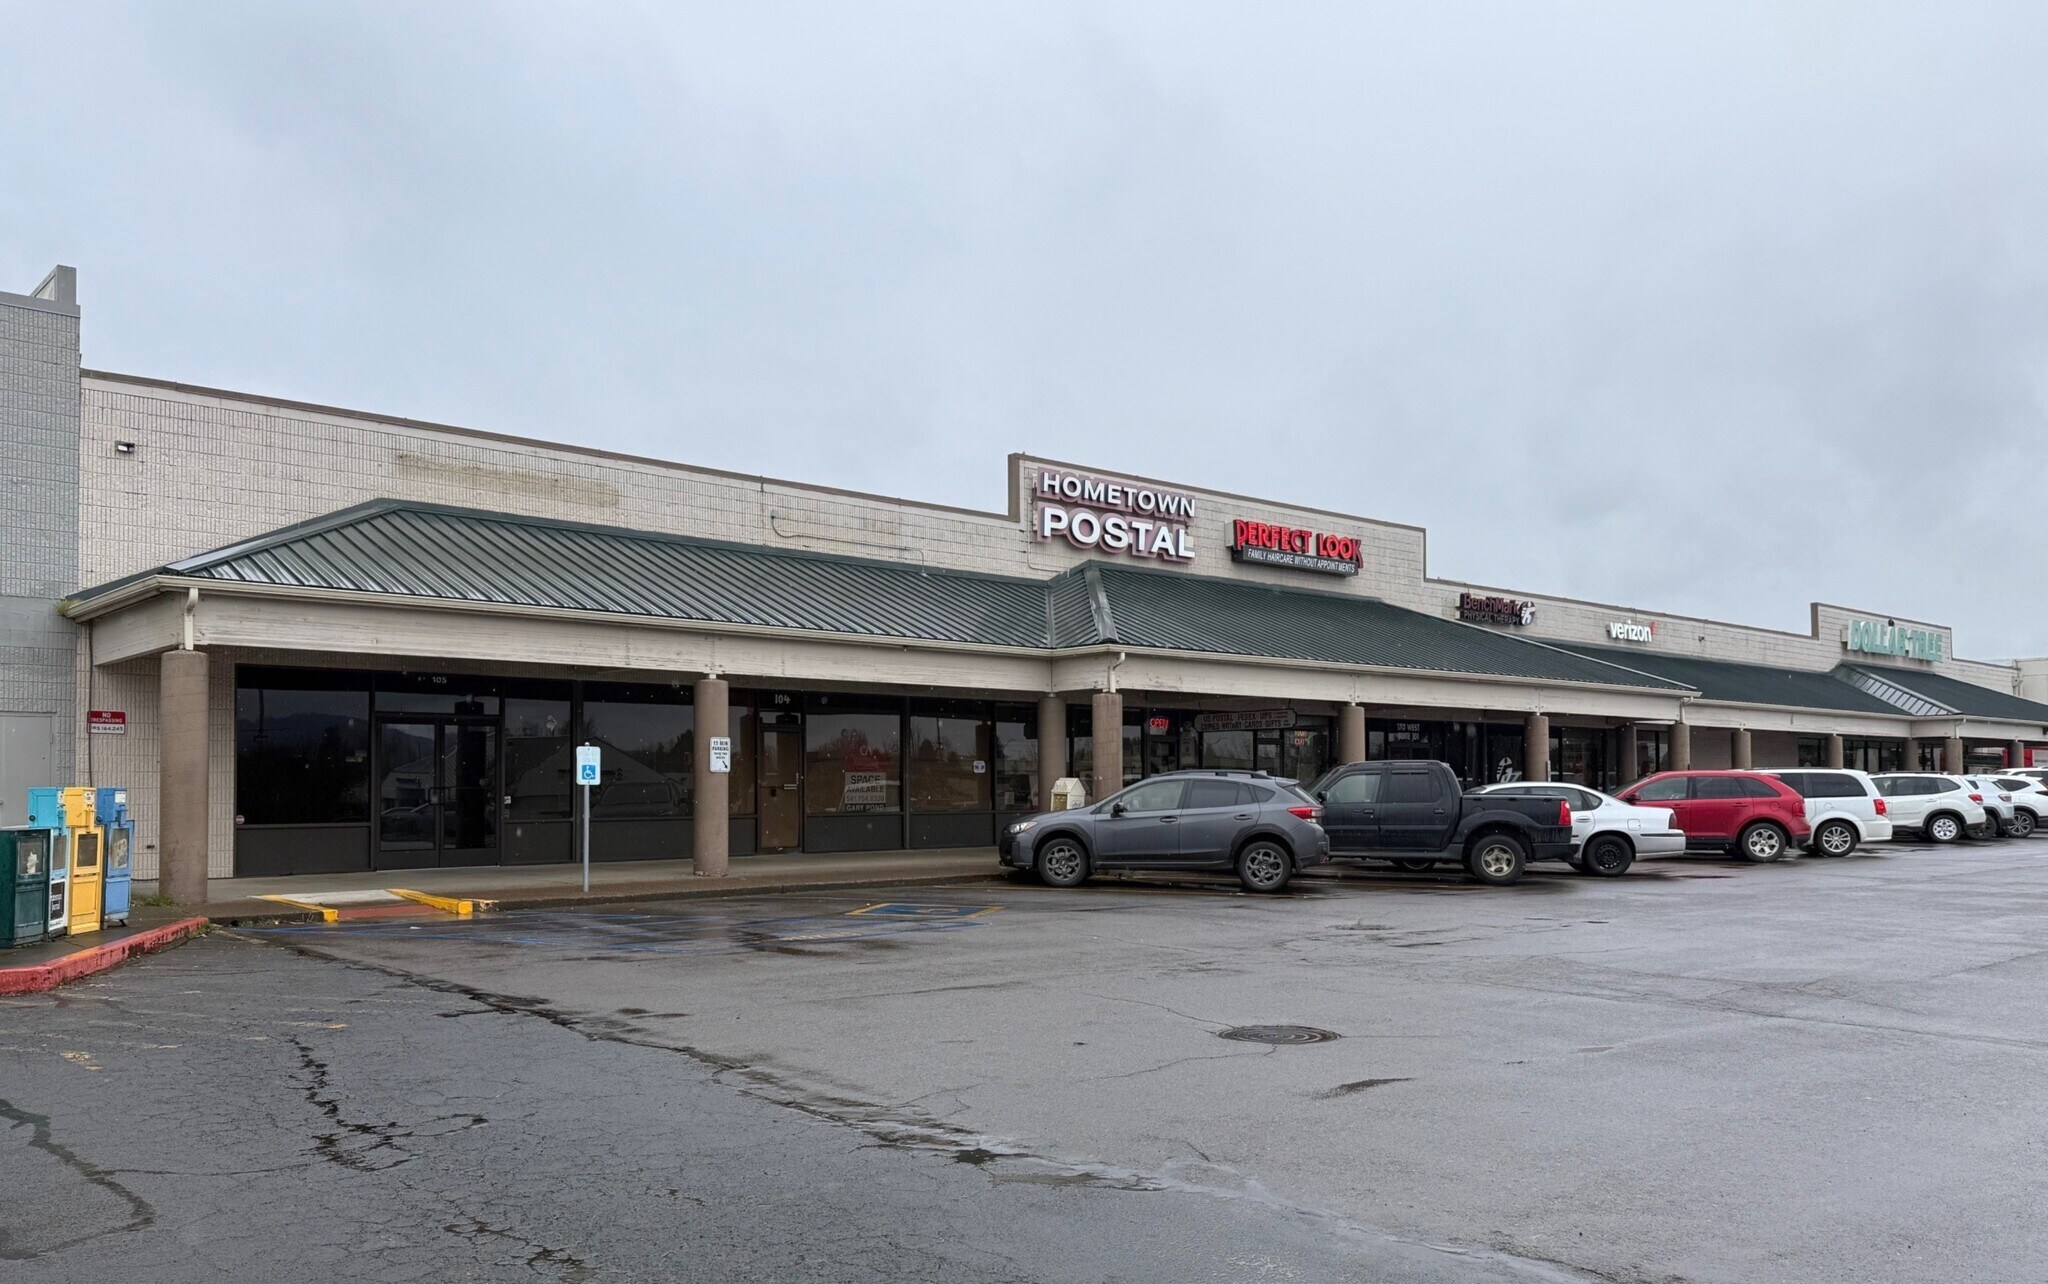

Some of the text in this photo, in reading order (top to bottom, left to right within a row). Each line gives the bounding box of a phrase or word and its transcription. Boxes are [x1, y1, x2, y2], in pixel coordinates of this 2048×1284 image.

[1042, 472, 1195, 517] HOMETOWN
[1043, 506, 1195, 558] POSTAL
[1234, 519, 1363, 568] PERFECT LOOK
[1247, 548, 1266, 559] FAMILY
[1267, 550, 1293, 564] HAIRCARE
[1294, 554, 1317, 568] WITHOUT
[1463, 593, 1520, 615] BenchMark
[1464, 610, 1520, 625] PHYSICAL THERAPY
[1610, 620, 1651, 642] verizon
[1850, 619, 1943, 663] DOLLAR TREE
[432, 676, 447, 684] 105
[774, 693, 791, 704] 104
[1149, 717, 1169, 728] OPEN
[846, 785, 884, 793] AVAILABLE
[850, 775, 881, 784] SPACE
